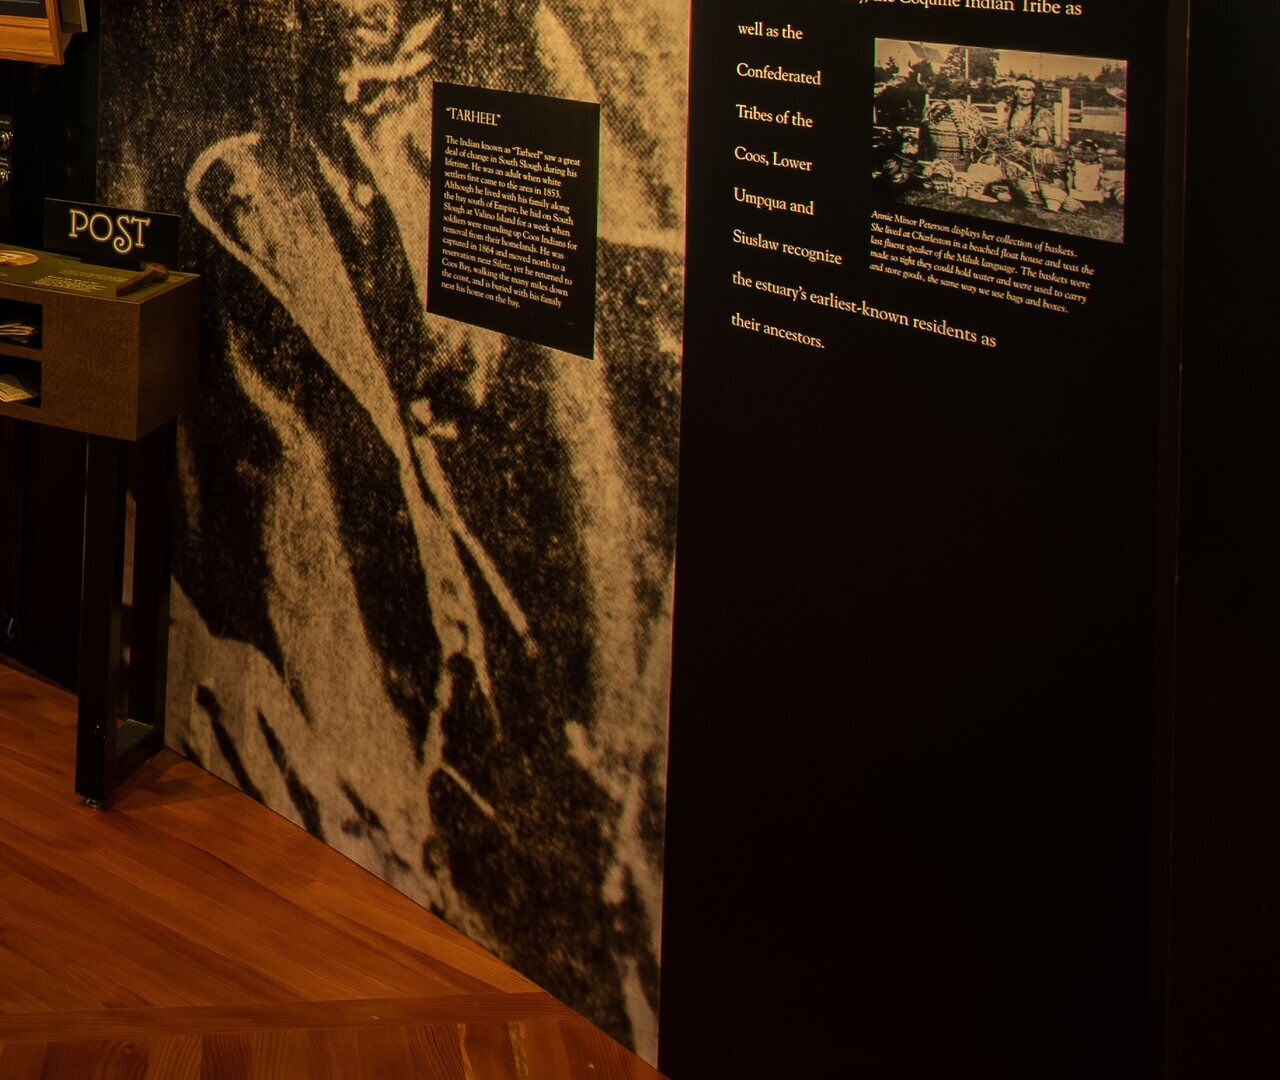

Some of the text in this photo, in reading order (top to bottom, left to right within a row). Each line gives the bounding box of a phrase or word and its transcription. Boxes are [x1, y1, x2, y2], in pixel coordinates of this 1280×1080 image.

[446, 135, 458, 145] The
[460, 137, 480, 149] Indian
[481, 141, 503, 153] known
[563, 158, 581, 166] great
[69, 209, 150, 254] POST
[871, 210, 1077, 258] Annie Minor Peterson displays her collection of baskets.
